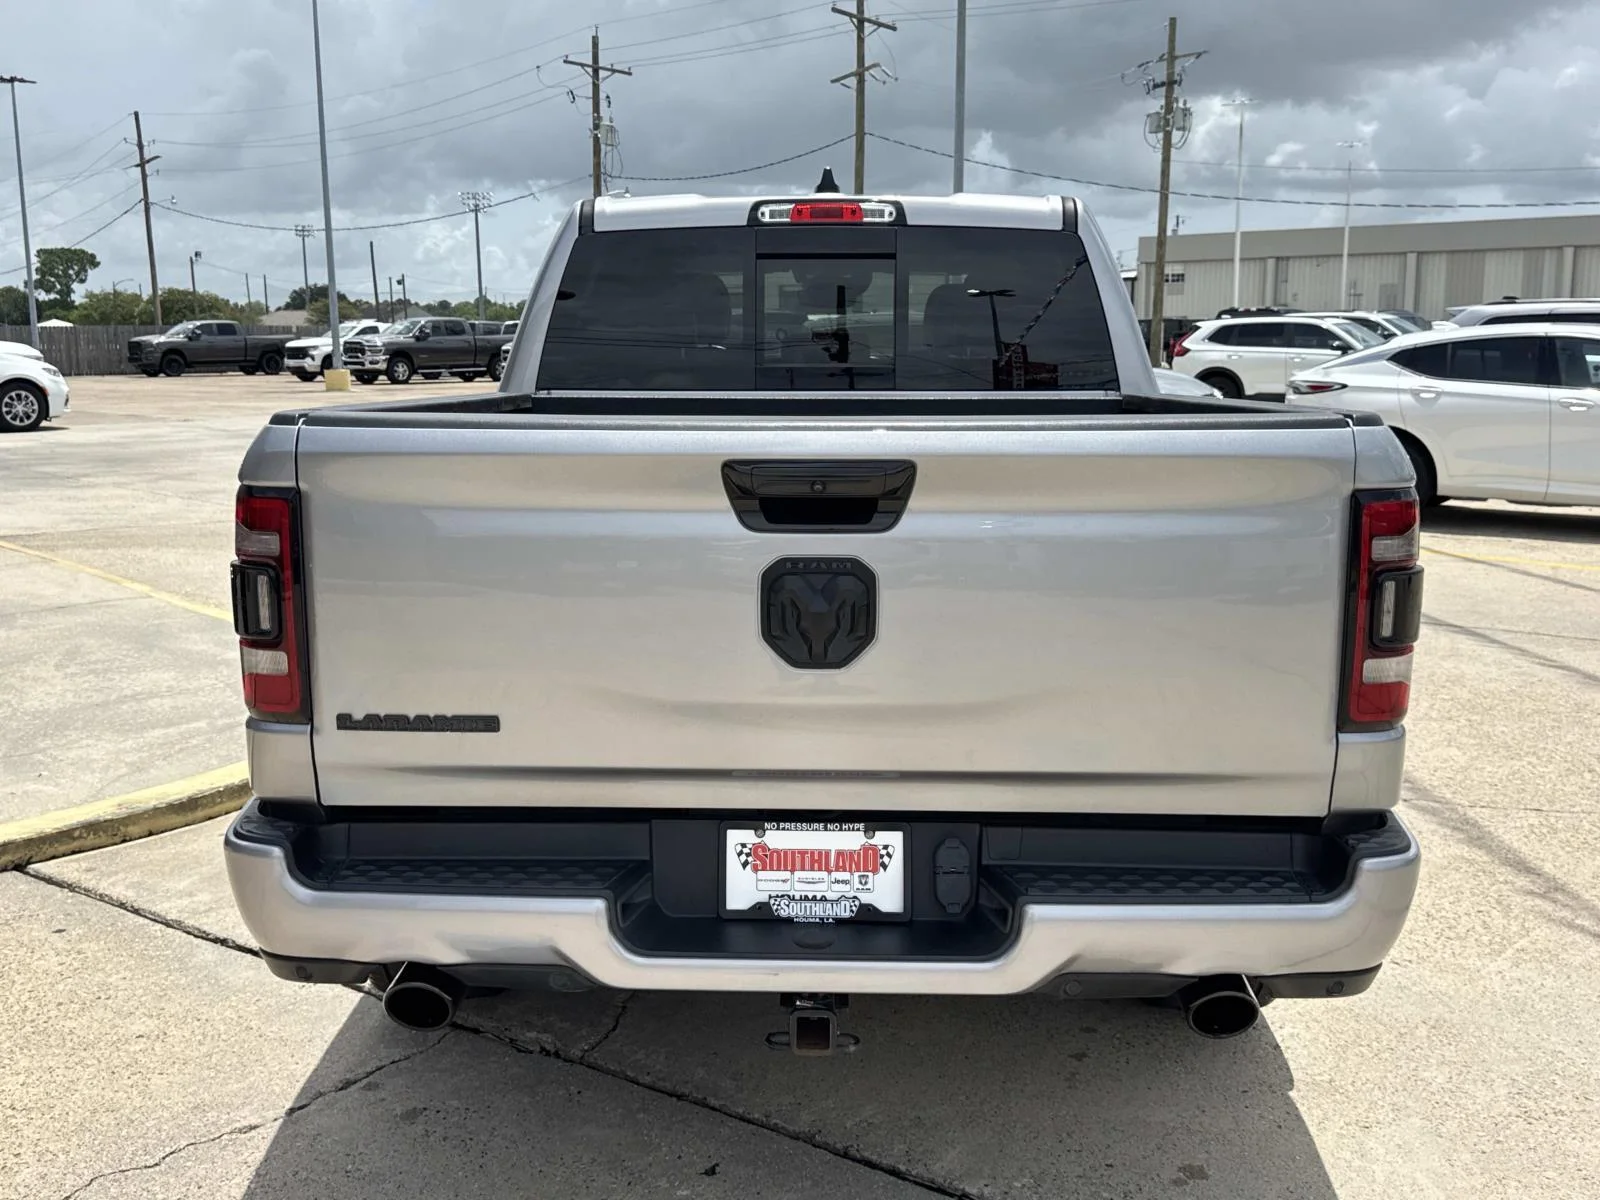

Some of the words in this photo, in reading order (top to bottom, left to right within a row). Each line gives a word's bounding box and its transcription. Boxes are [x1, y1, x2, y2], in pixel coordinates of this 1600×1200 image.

[786, 561, 851, 569] RAM
[764, 822, 778, 830] NO
[779, 822, 825, 831] PRESSURE
[827, 823, 841, 831] NO
[842, 823, 865, 831] HYPE
[751, 843, 880, 874] SOUTHLAND
[831, 877, 850, 886] Jeep
[780, 899, 850, 917] SOUTHLAND
